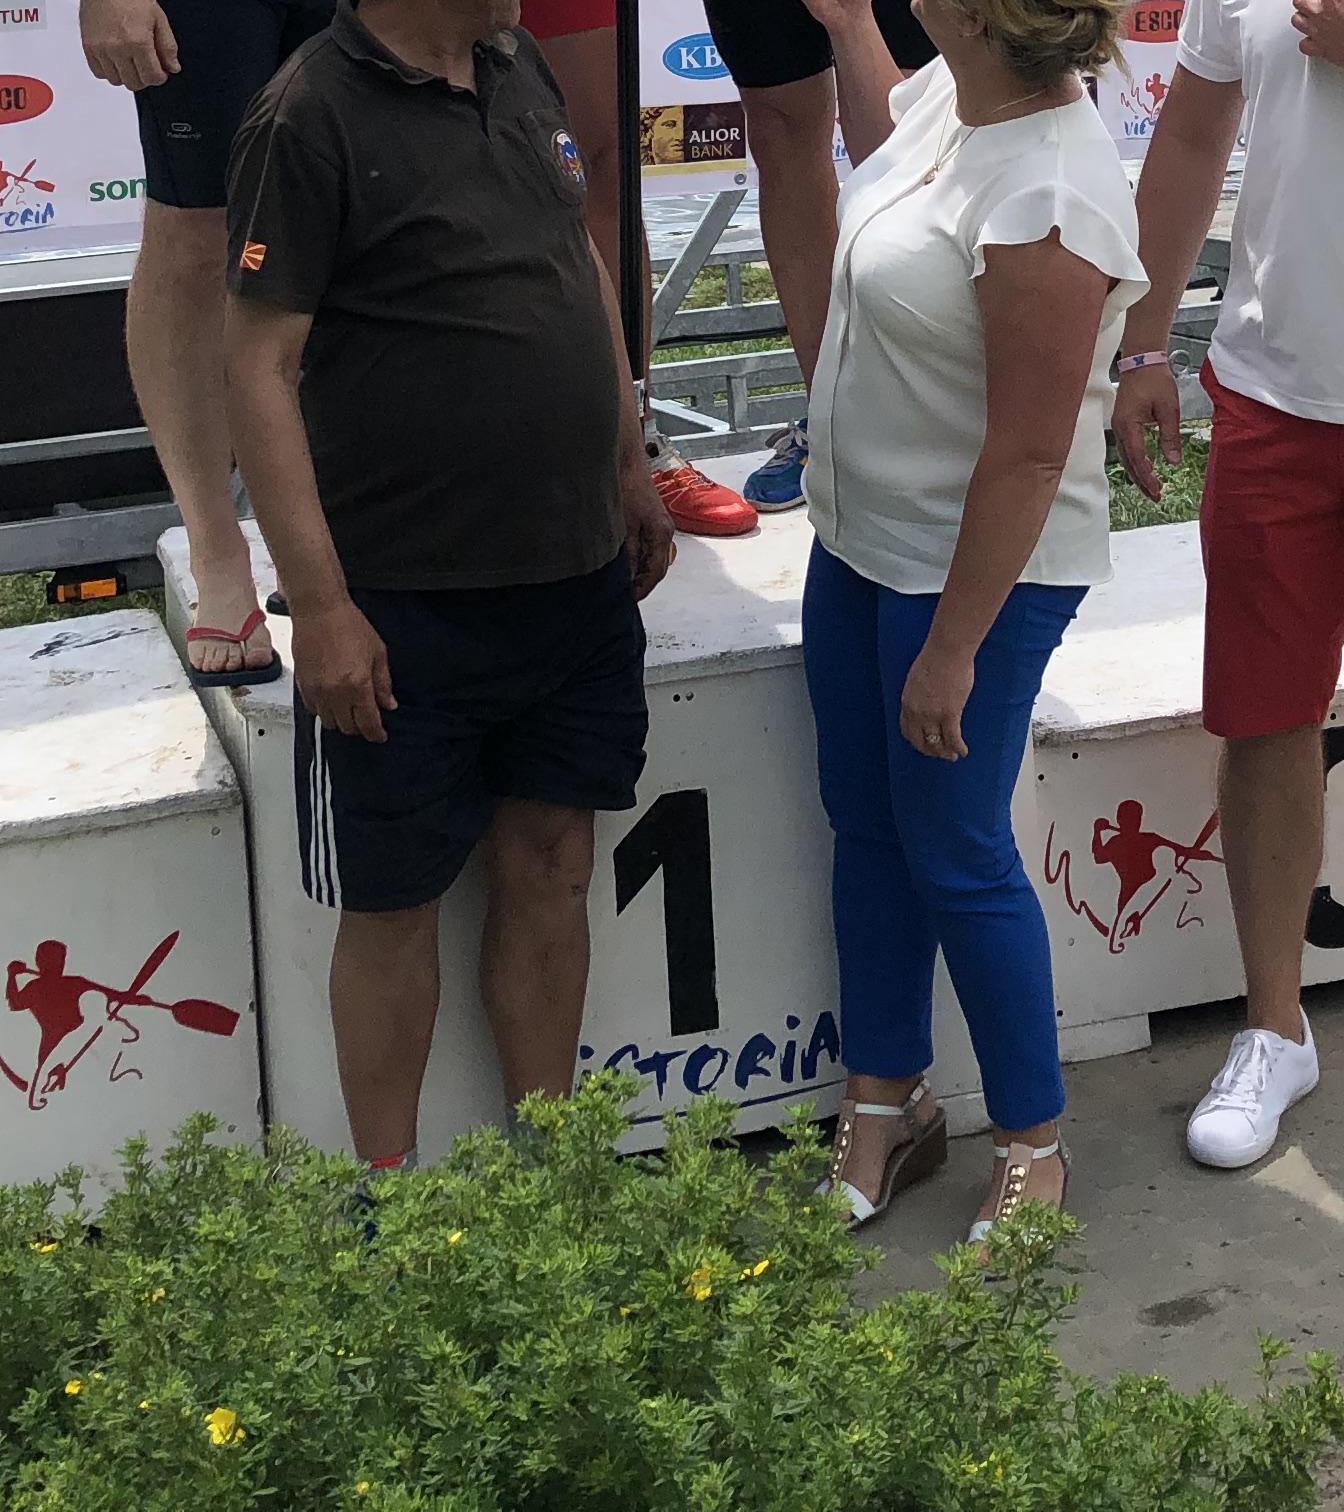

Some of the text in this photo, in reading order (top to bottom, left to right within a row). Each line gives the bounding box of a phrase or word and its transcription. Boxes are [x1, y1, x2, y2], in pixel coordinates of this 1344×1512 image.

[677, 45, 728, 72] KB
[689, 127, 741, 144] ALIOR
[691, 143, 734, 160] BANK
[89, 177, 146, 202] son
[613, 788, 720, 1037] 1
